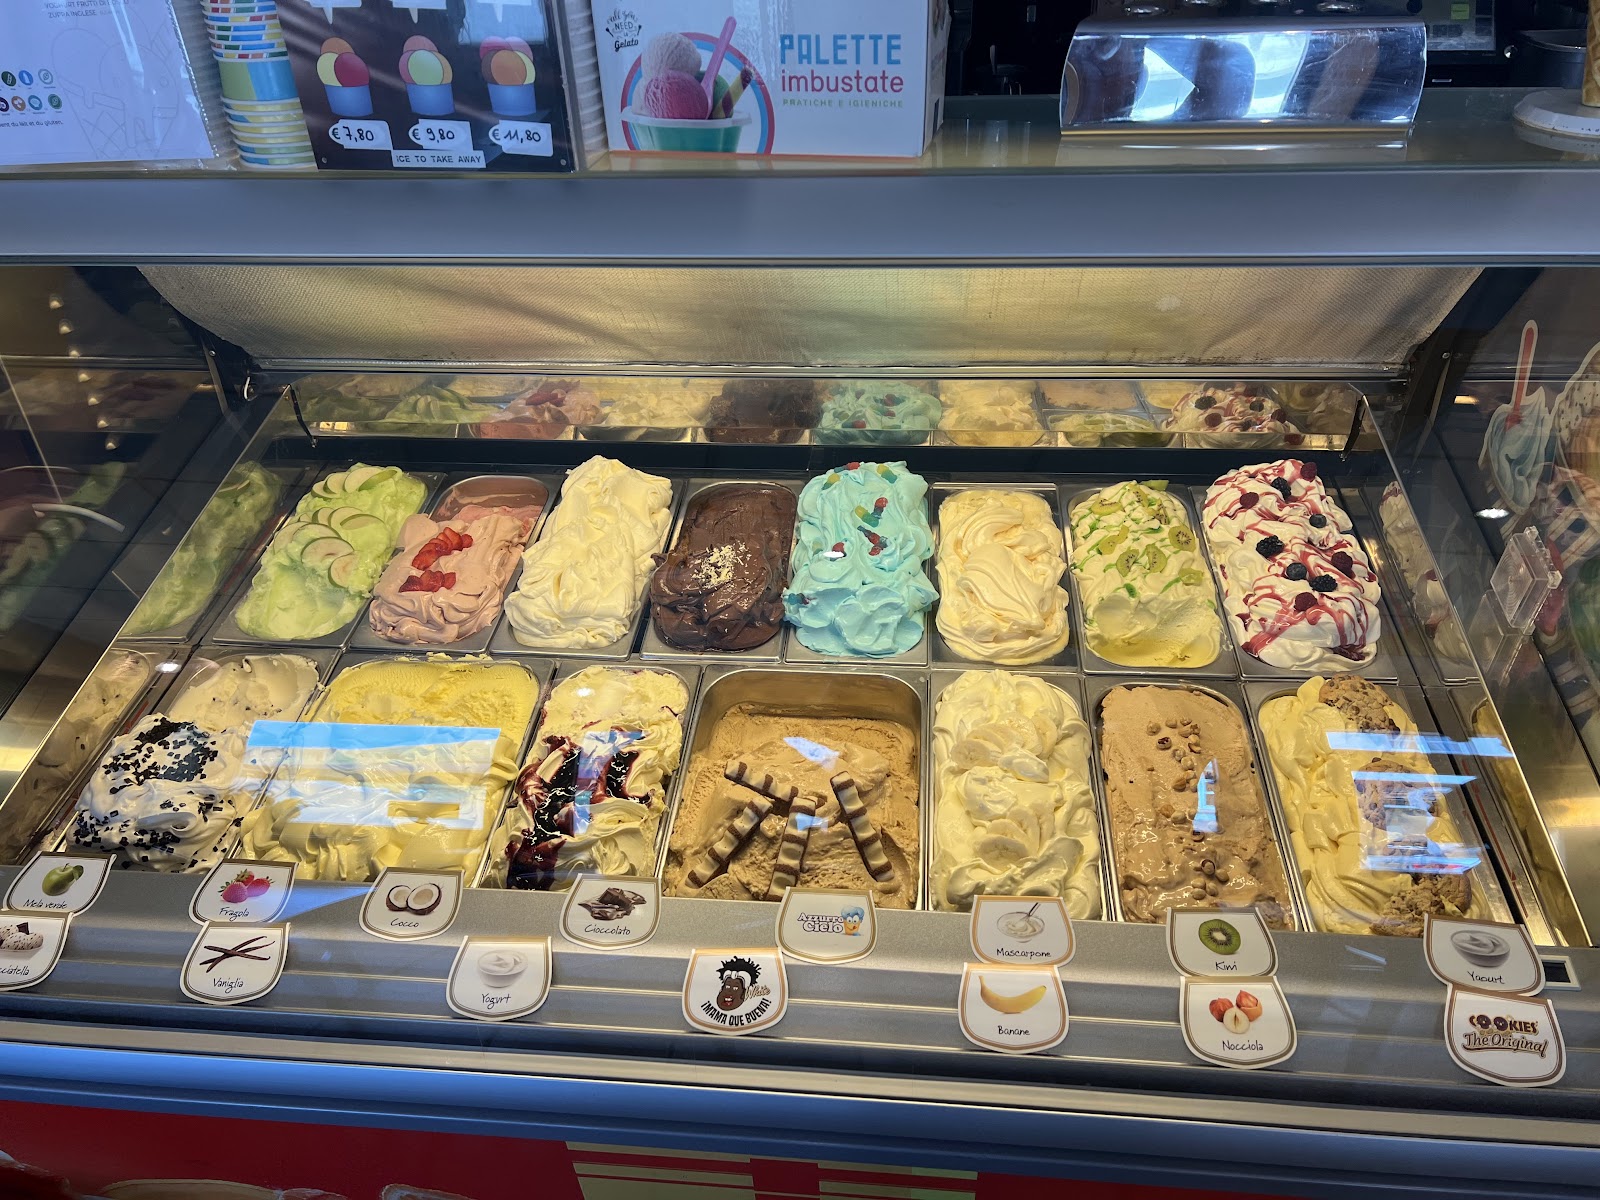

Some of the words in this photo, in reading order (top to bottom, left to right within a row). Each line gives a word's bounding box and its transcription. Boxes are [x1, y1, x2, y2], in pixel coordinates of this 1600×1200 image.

[614, 21, 634, 30] NEED
[614, 37, 639, 52] Gelato
[780, 34, 902, 65] PALETTE
[781, 69, 904, 93] imbustate
[782, 99, 833, 107] PRATICHE
[838, 99, 844, 108] E
[848, 99, 904, 108] IGIENICHE
[426, 127, 455, 143] 9,80
[396, 155, 411, 163] ICE
[414, 155, 427, 163] TO
[430, 155, 454, 163] TAKE
[458, 155, 482, 164] AWAY
[22, 898, 44, 908] Mela
[218, 906, 250, 921] Fragola
[797, 912, 844, 922] Azzurro
[390, 917, 420, 929] Cocco
[584, 923, 631, 936] Cioccolato
[803, 921, 844, 933] Cielo
[996, 947, 1052, 959] Mascarpone
[1467, 971, 1505, 984] Yaourt
[212, 976, 244, 993] Vaniglia
[745, 985, 771, 1001] White
[481, 993, 512, 1009] Yogurt
[728, 1014, 745, 1027] QUE
[745, 998, 772, 1024] BUENA!
[1469, 1014, 1538, 1032] COOKIES
[997, 1025, 1031, 1037] Banane
[1222, 1039, 1264, 1051] Nocciola
[1464, 1032, 1488, 1047] The
[1490, 1034, 1548, 1057] Original
